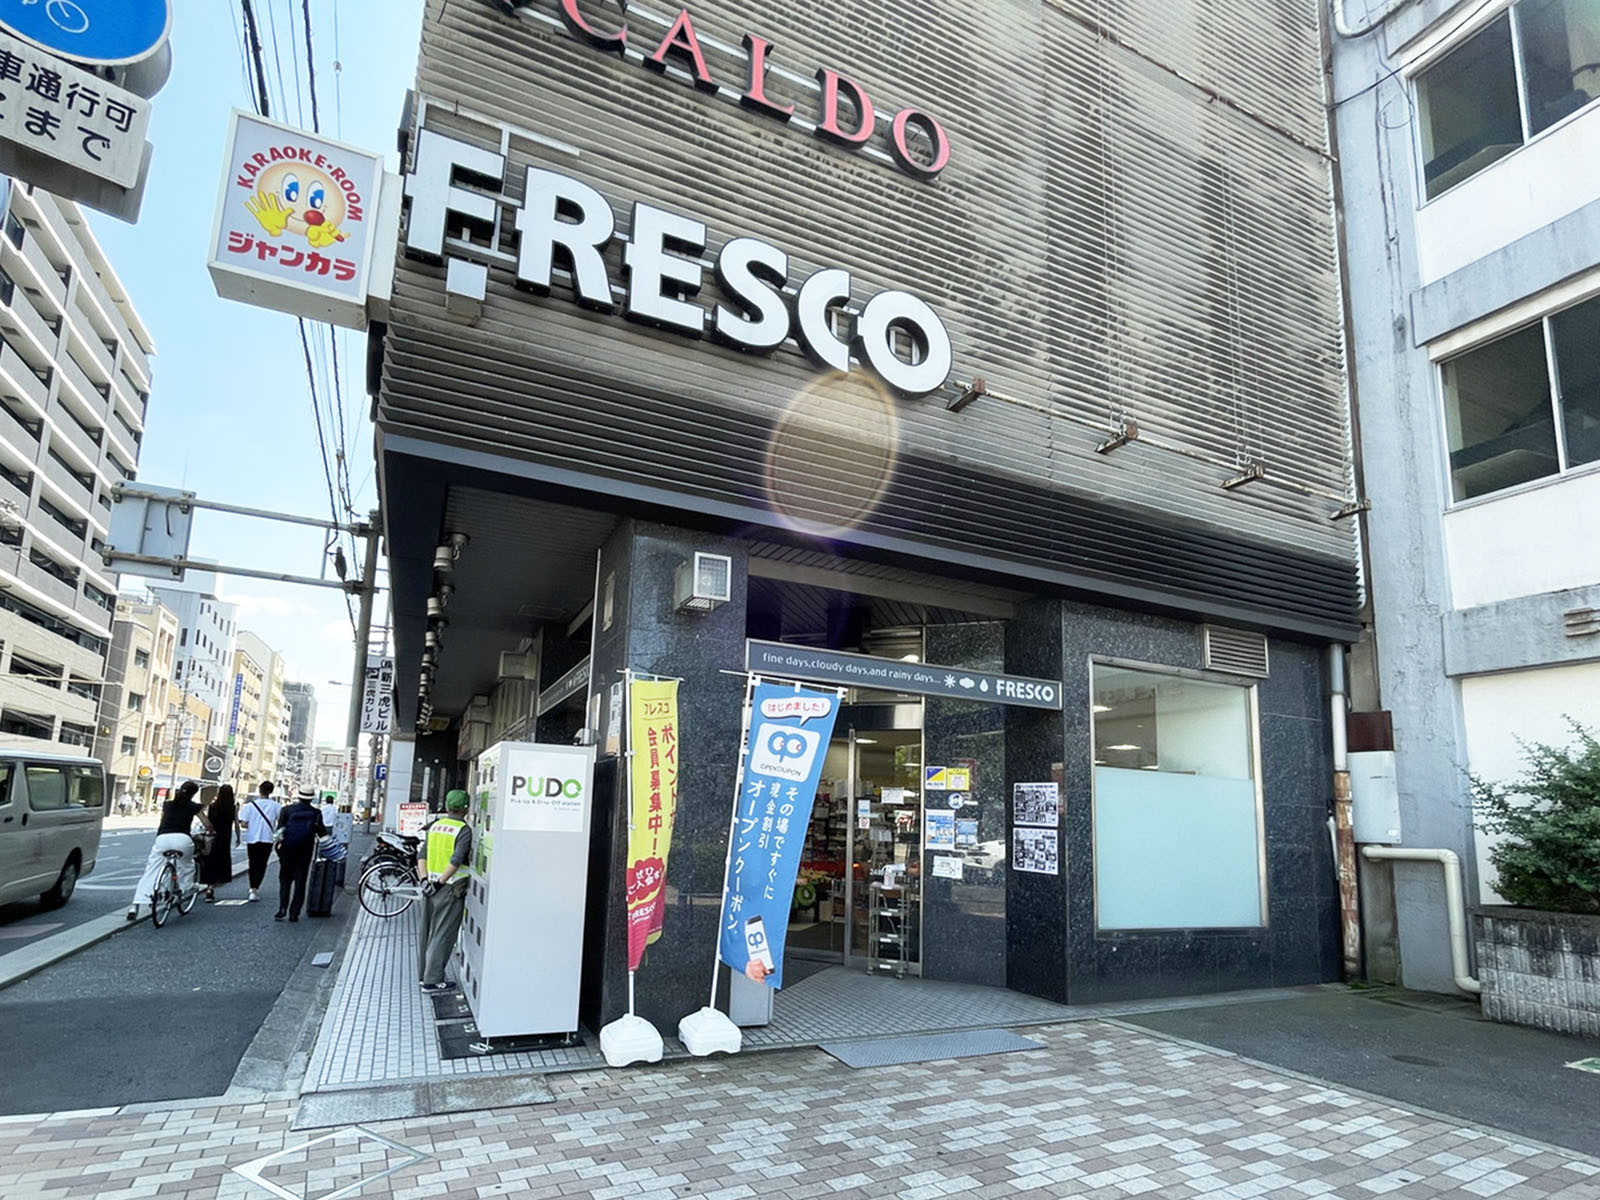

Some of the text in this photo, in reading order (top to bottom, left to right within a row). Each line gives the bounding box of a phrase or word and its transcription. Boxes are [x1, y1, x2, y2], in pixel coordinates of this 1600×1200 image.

[559, 0, 951, 178] CALDO
[227, 231, 357, 281] ジャンカラ
[403, 128, 953, 394] FRESCO
[762, 652, 784, 664] fine
[888, 667, 912, 681] rainy
[997, 679, 1054, 702] FRESCO
[512, 775, 582, 799] PUDO
[758, 782, 781, 849] 現金割引
[763, 786, 799, 900] その場ですぐに
